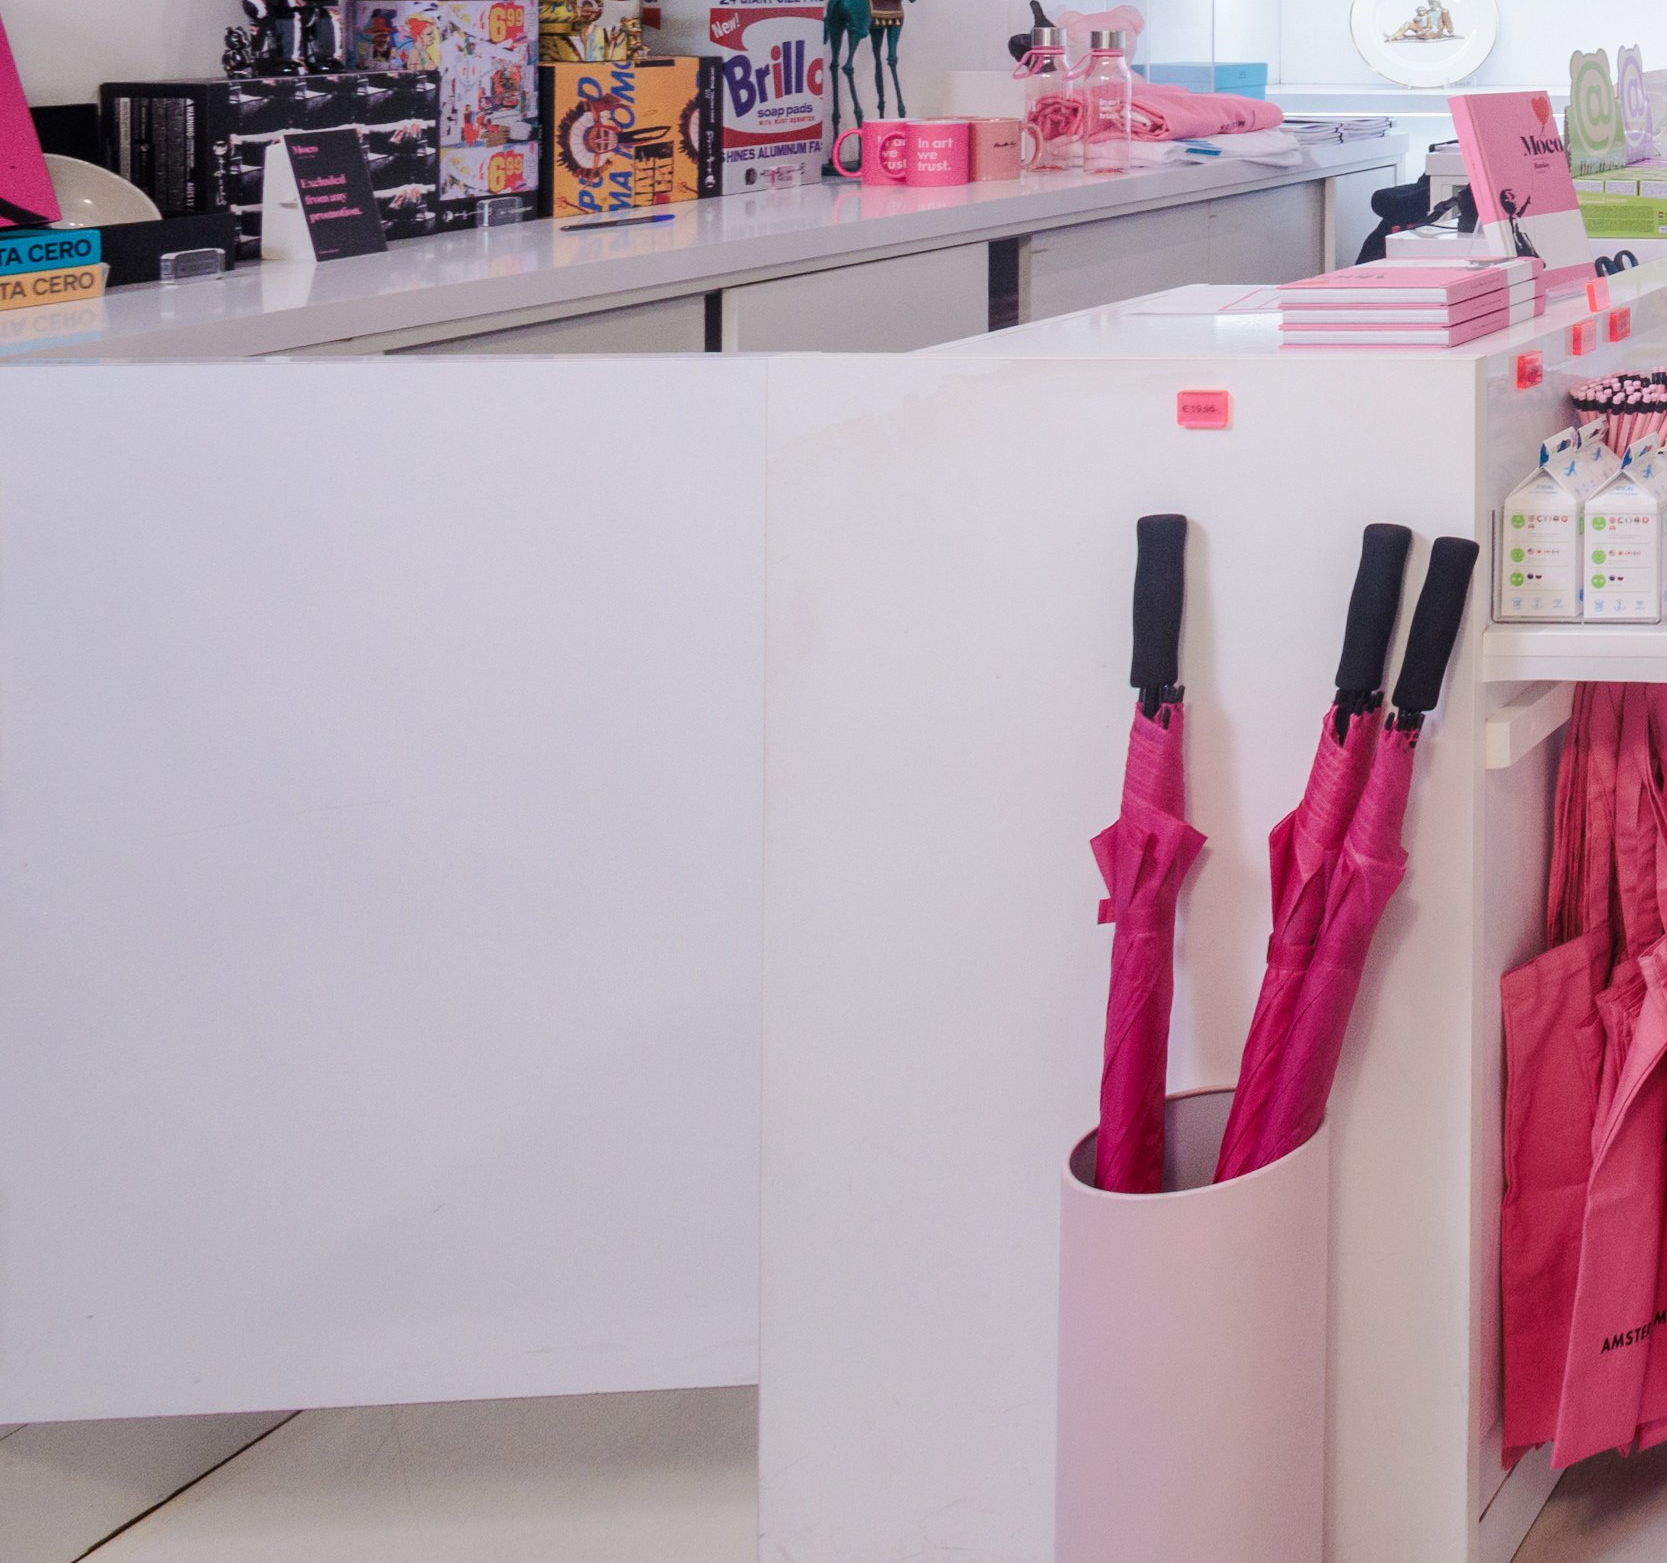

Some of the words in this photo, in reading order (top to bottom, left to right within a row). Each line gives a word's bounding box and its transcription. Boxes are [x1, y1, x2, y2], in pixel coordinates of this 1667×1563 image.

[711, 12, 741, 39] New!
[757, 106, 784, 119] soap
[786, 102, 813, 117] pads
[917, 138, 928, 149] In
[929, 138, 954, 149] art
[1520, 134, 1565, 157] Moco
[722, 149, 756, 163] SHINES
[758, 143, 807, 160] ALUMINUM
[917, 150, 938, 160] we
[917, 160, 952, 171] trust.
[300, 174, 347, 189] Excluded
[304, 194, 330, 206] from
[330, 192, 348, 204] any
[308, 206, 363, 224] promotion.
[28, 239, 92, 262] CERO
[32, 272, 95, 295] CERO
